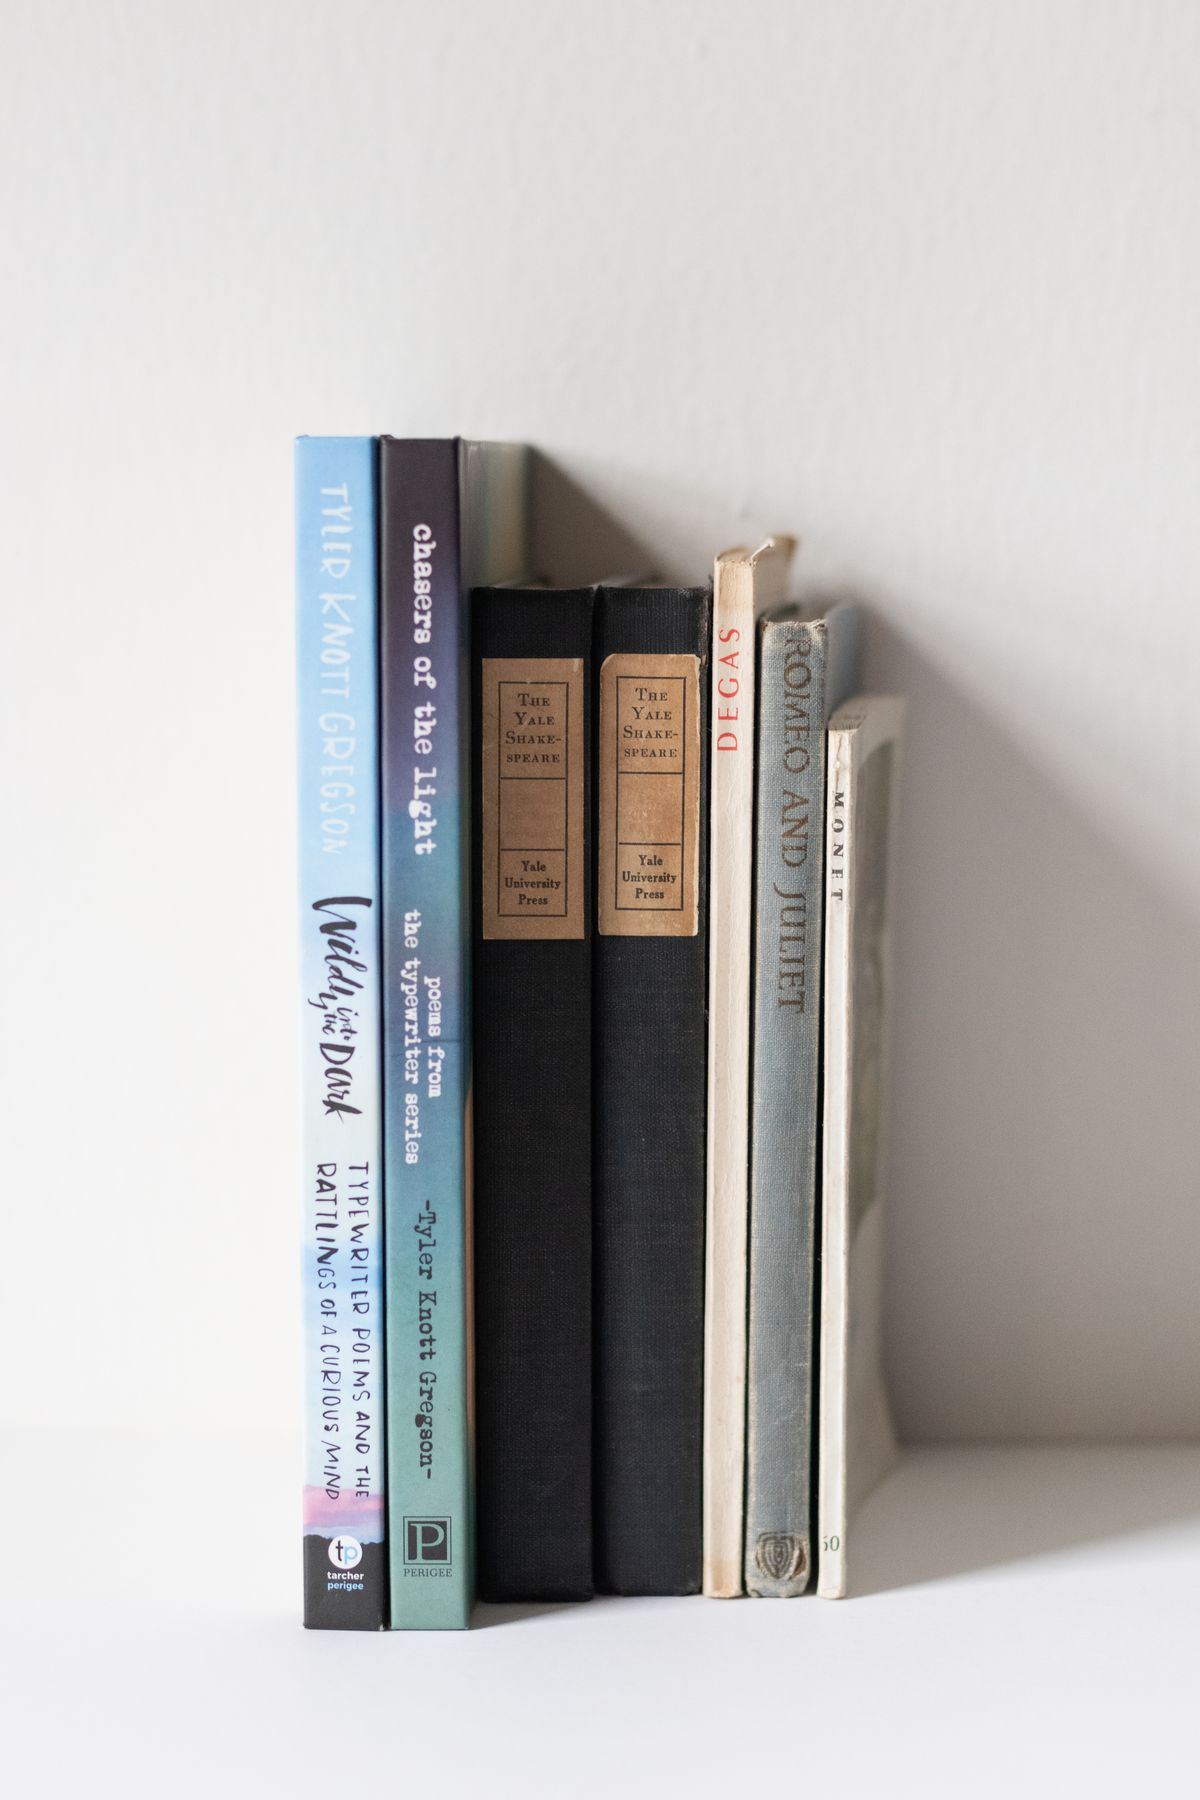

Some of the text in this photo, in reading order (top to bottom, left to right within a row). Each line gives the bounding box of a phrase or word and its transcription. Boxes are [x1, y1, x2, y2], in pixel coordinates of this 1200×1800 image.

[319, 483, 357, 855] TYLER KNOTT GREGSON
[408, 523, 437, 856] chasers of the light
[635, 687, 668, 701] THE
[717, 627, 741, 752] DEGAS
[517, 693, 551, 707] THE
[514, 712, 555, 725] YALE
[631, 706, 672, 721] YALE
[505, 731, 562, 745] SHAKE-
[623, 725, 679, 739] SHAKE-
[506, 753, 560, 763] SPEARE
[624, 748, 678, 758] SPEARE
[773, 637, 812, 1014] ROMEO AND JULIET
[830, 791, 845, 901] MONET
[521, 860, 547, 872] Yale
[638, 854, 663, 866] Yale
[504, 877, 561, 890] University
[622, 871, 677, 884] University
[518, 894, 548, 906] Press
[635, 888, 665, 900] Press
[308, 896, 372, 1010] Wildly
[400, 909, 422, 1164] the typewriter series
[424, 976, 445, 1098] poems from
[319, 1042, 363, 1125] Dark
[315, 1162, 341, 1500] RATTLINGS OF A CURIOUS MIND
[348, 1161, 370, 1498] TYPEWRITER POEMS AND THE
[419, 1290, 437, 1360] Knott
[327, 1571, 364, 1580] tarcher
[404, 1568, 452, 1577] PERIGEE
[327, 1581, 364, 1591] perigee
